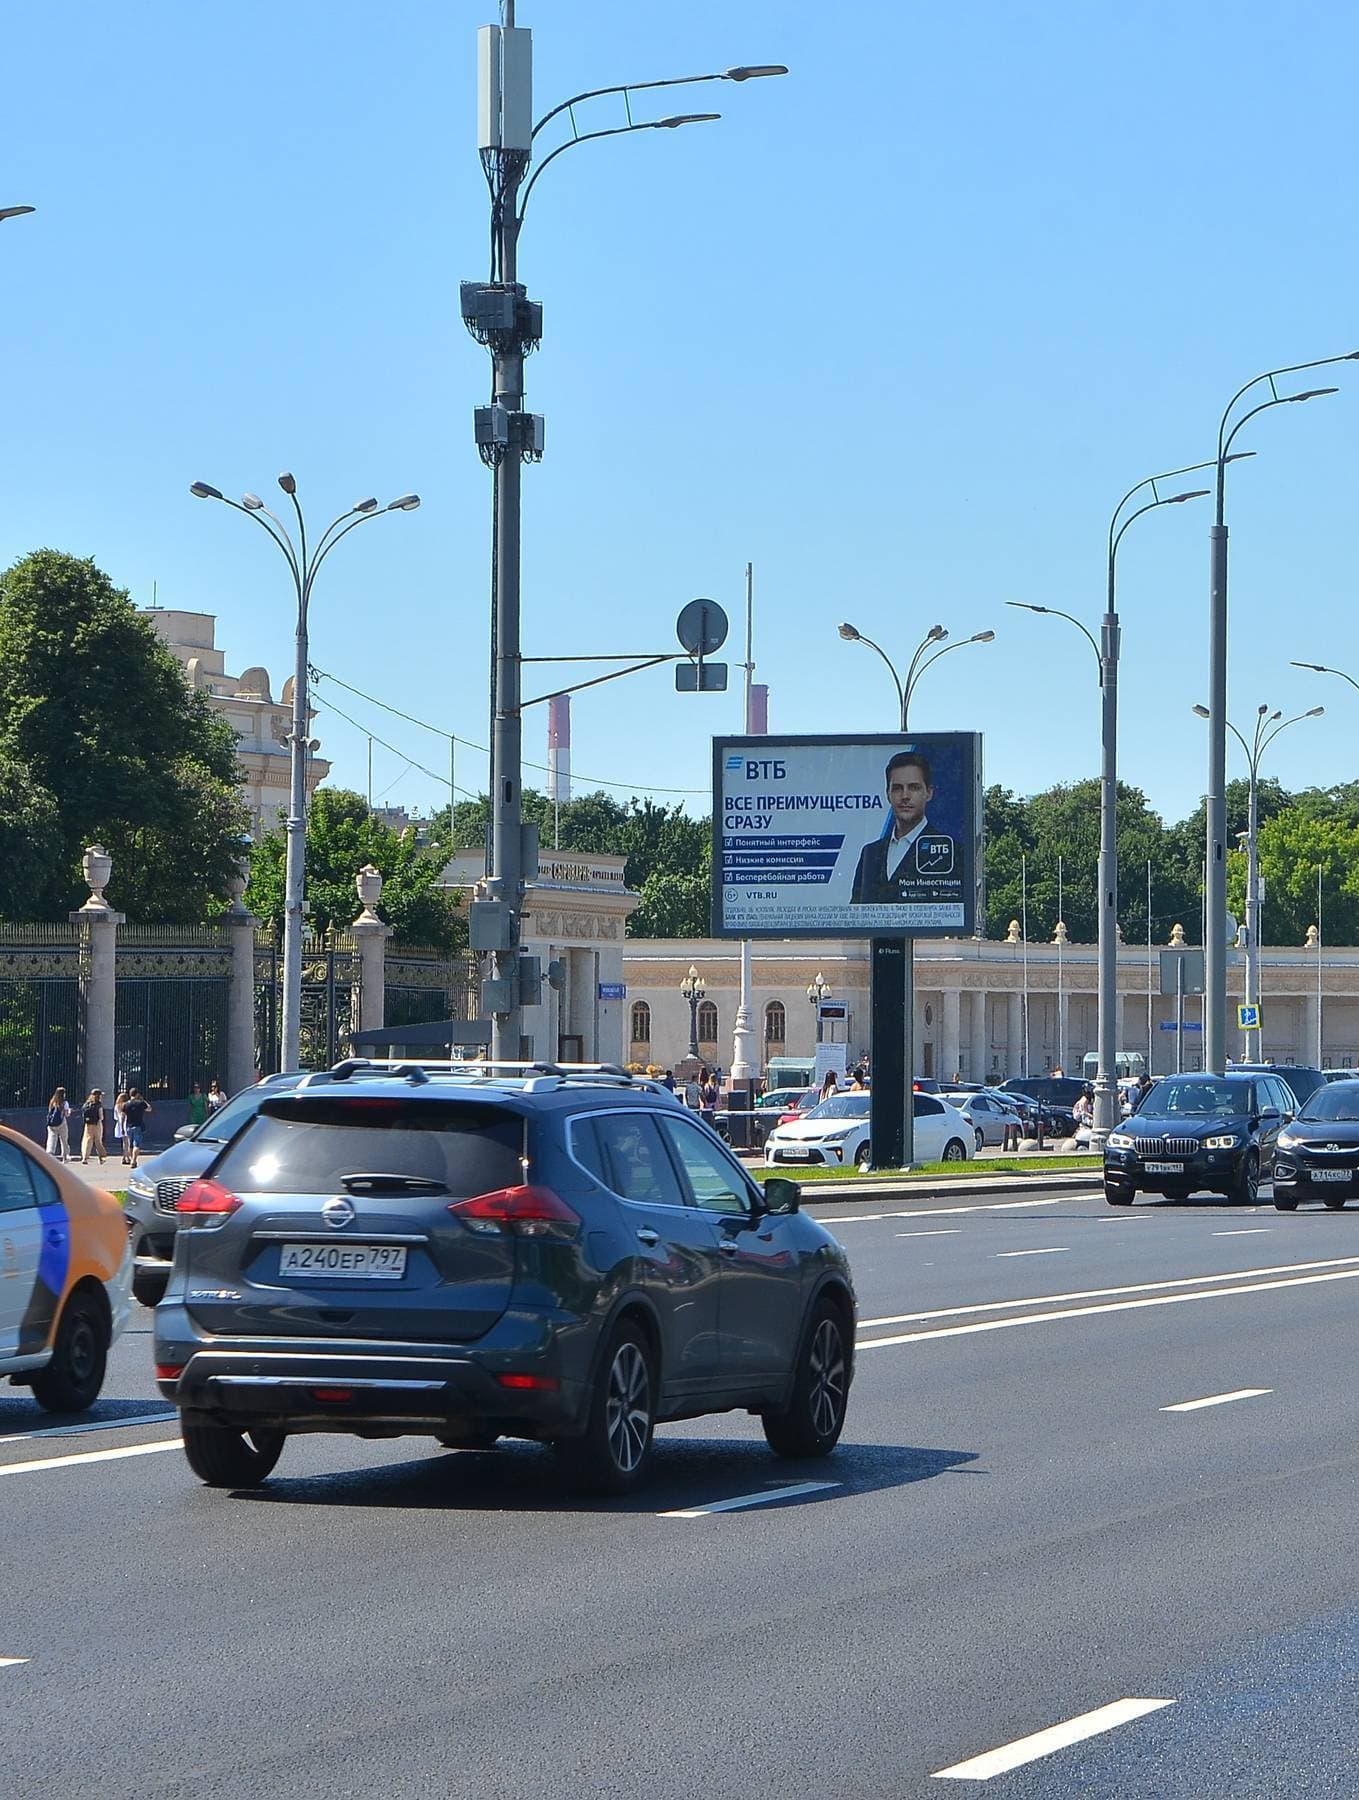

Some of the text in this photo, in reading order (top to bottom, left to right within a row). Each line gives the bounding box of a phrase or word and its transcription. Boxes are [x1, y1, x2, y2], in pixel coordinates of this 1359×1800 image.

[746, 760, 786, 780] ВТБ
[725, 795, 883, 812] ВСЕ ПРЕИМУЩЕСТВА
[725, 815, 773, 830] СРАЗУ
[735, 837, 821, 848] Понятный интерфейс
[930, 844, 949, 854] ВТБ
[735, 856, 764, 864] Низкие
[735, 871, 825, 882] Бесперебойная работа
[917, 878, 961, 887] Инвестиции
[746, 891, 777, 899] VTB.RU
